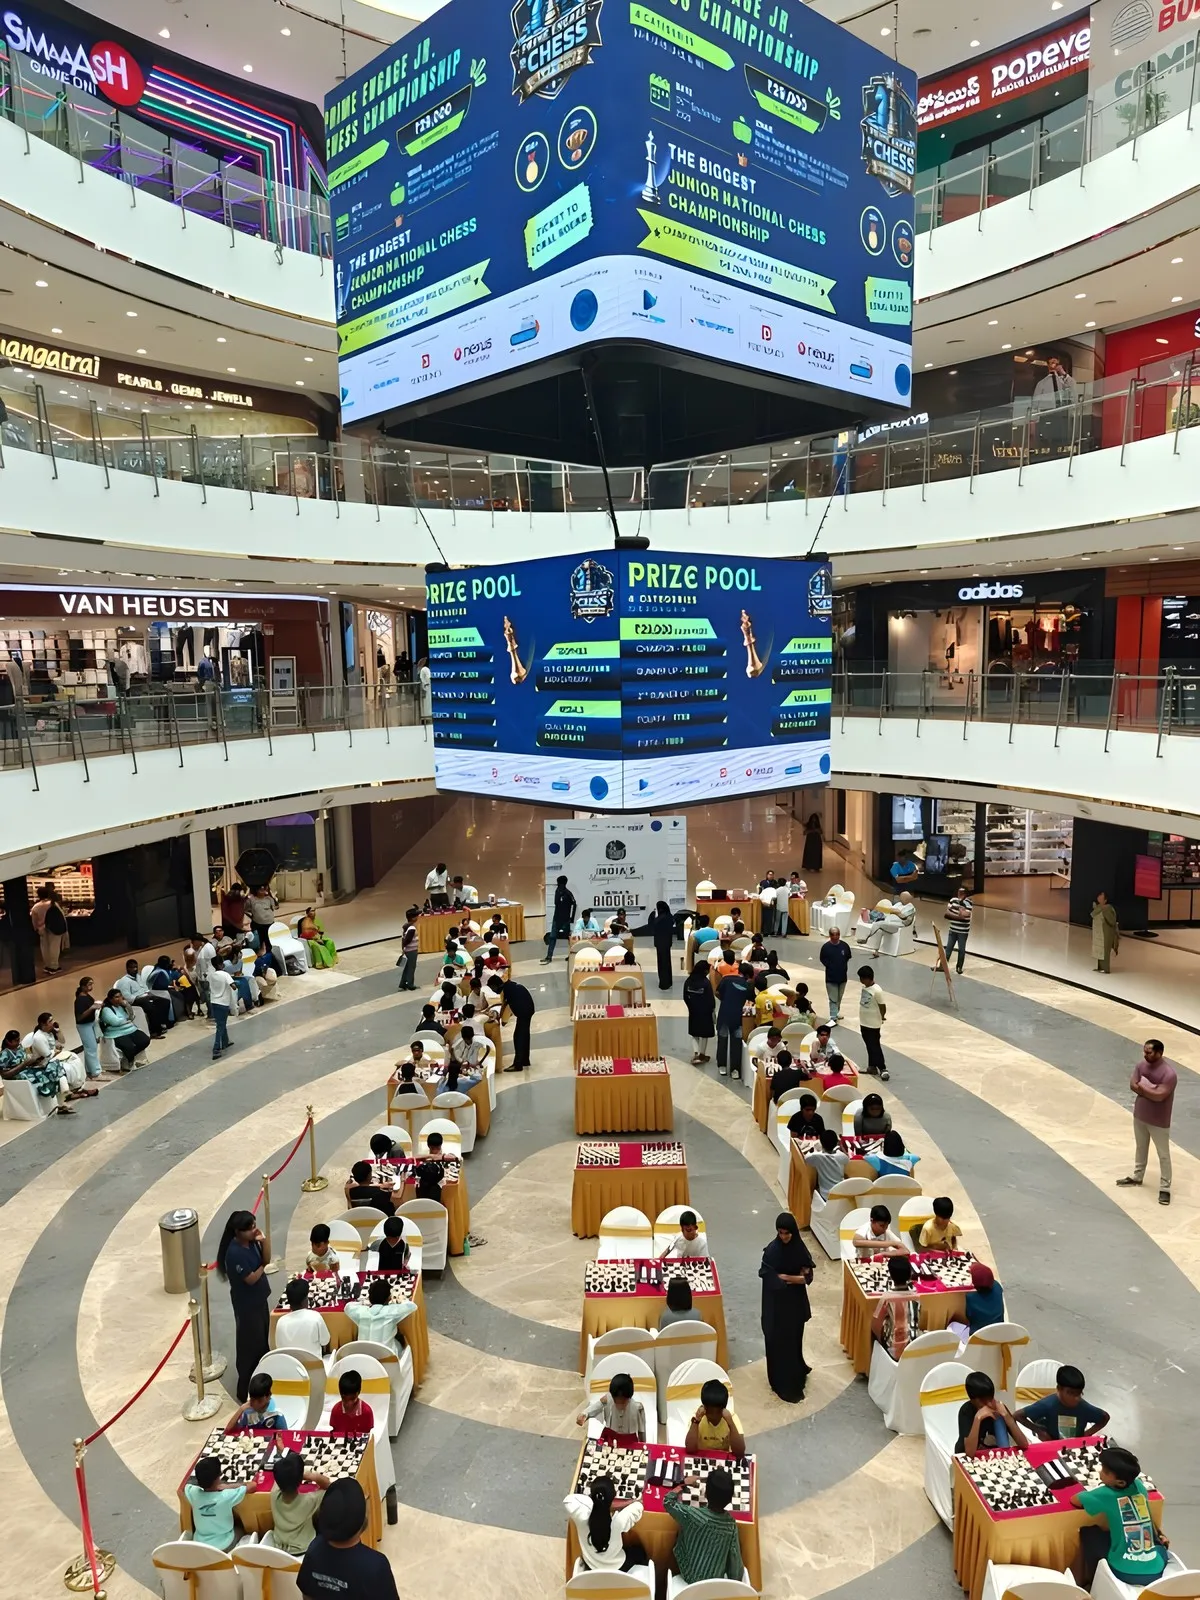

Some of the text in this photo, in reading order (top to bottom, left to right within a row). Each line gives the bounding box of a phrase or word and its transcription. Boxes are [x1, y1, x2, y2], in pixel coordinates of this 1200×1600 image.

[3, 11, 129, 91] SMAAASH
[527, 17, 588, 73] CHESS
[699, 0, 819, 81] CHAMPIONSHIP
[362, 52, 408, 107] ENGAGE
[363, 47, 461, 136] CHAMPIONSHIP
[667, 142, 757, 195] THE BIGGEST
[873, 139, 915, 176] CHESS
[668, 169, 826, 246] JUNIOR NATIONAL CHESS
[668, 192, 771, 243] CHAMPIONSHIP
[386, 238, 438, 274] NATIONAL
[439, 217, 477, 247] CHESS
[171, 383, 203, 398] GEMS
[472, 573, 521, 601] POOL
[628, 561, 762, 591] PRIZE POOL
[958, 581, 1023, 601] adidas
[59, 593, 114, 615] VAN
[122, 596, 229, 617] HEUSEN
